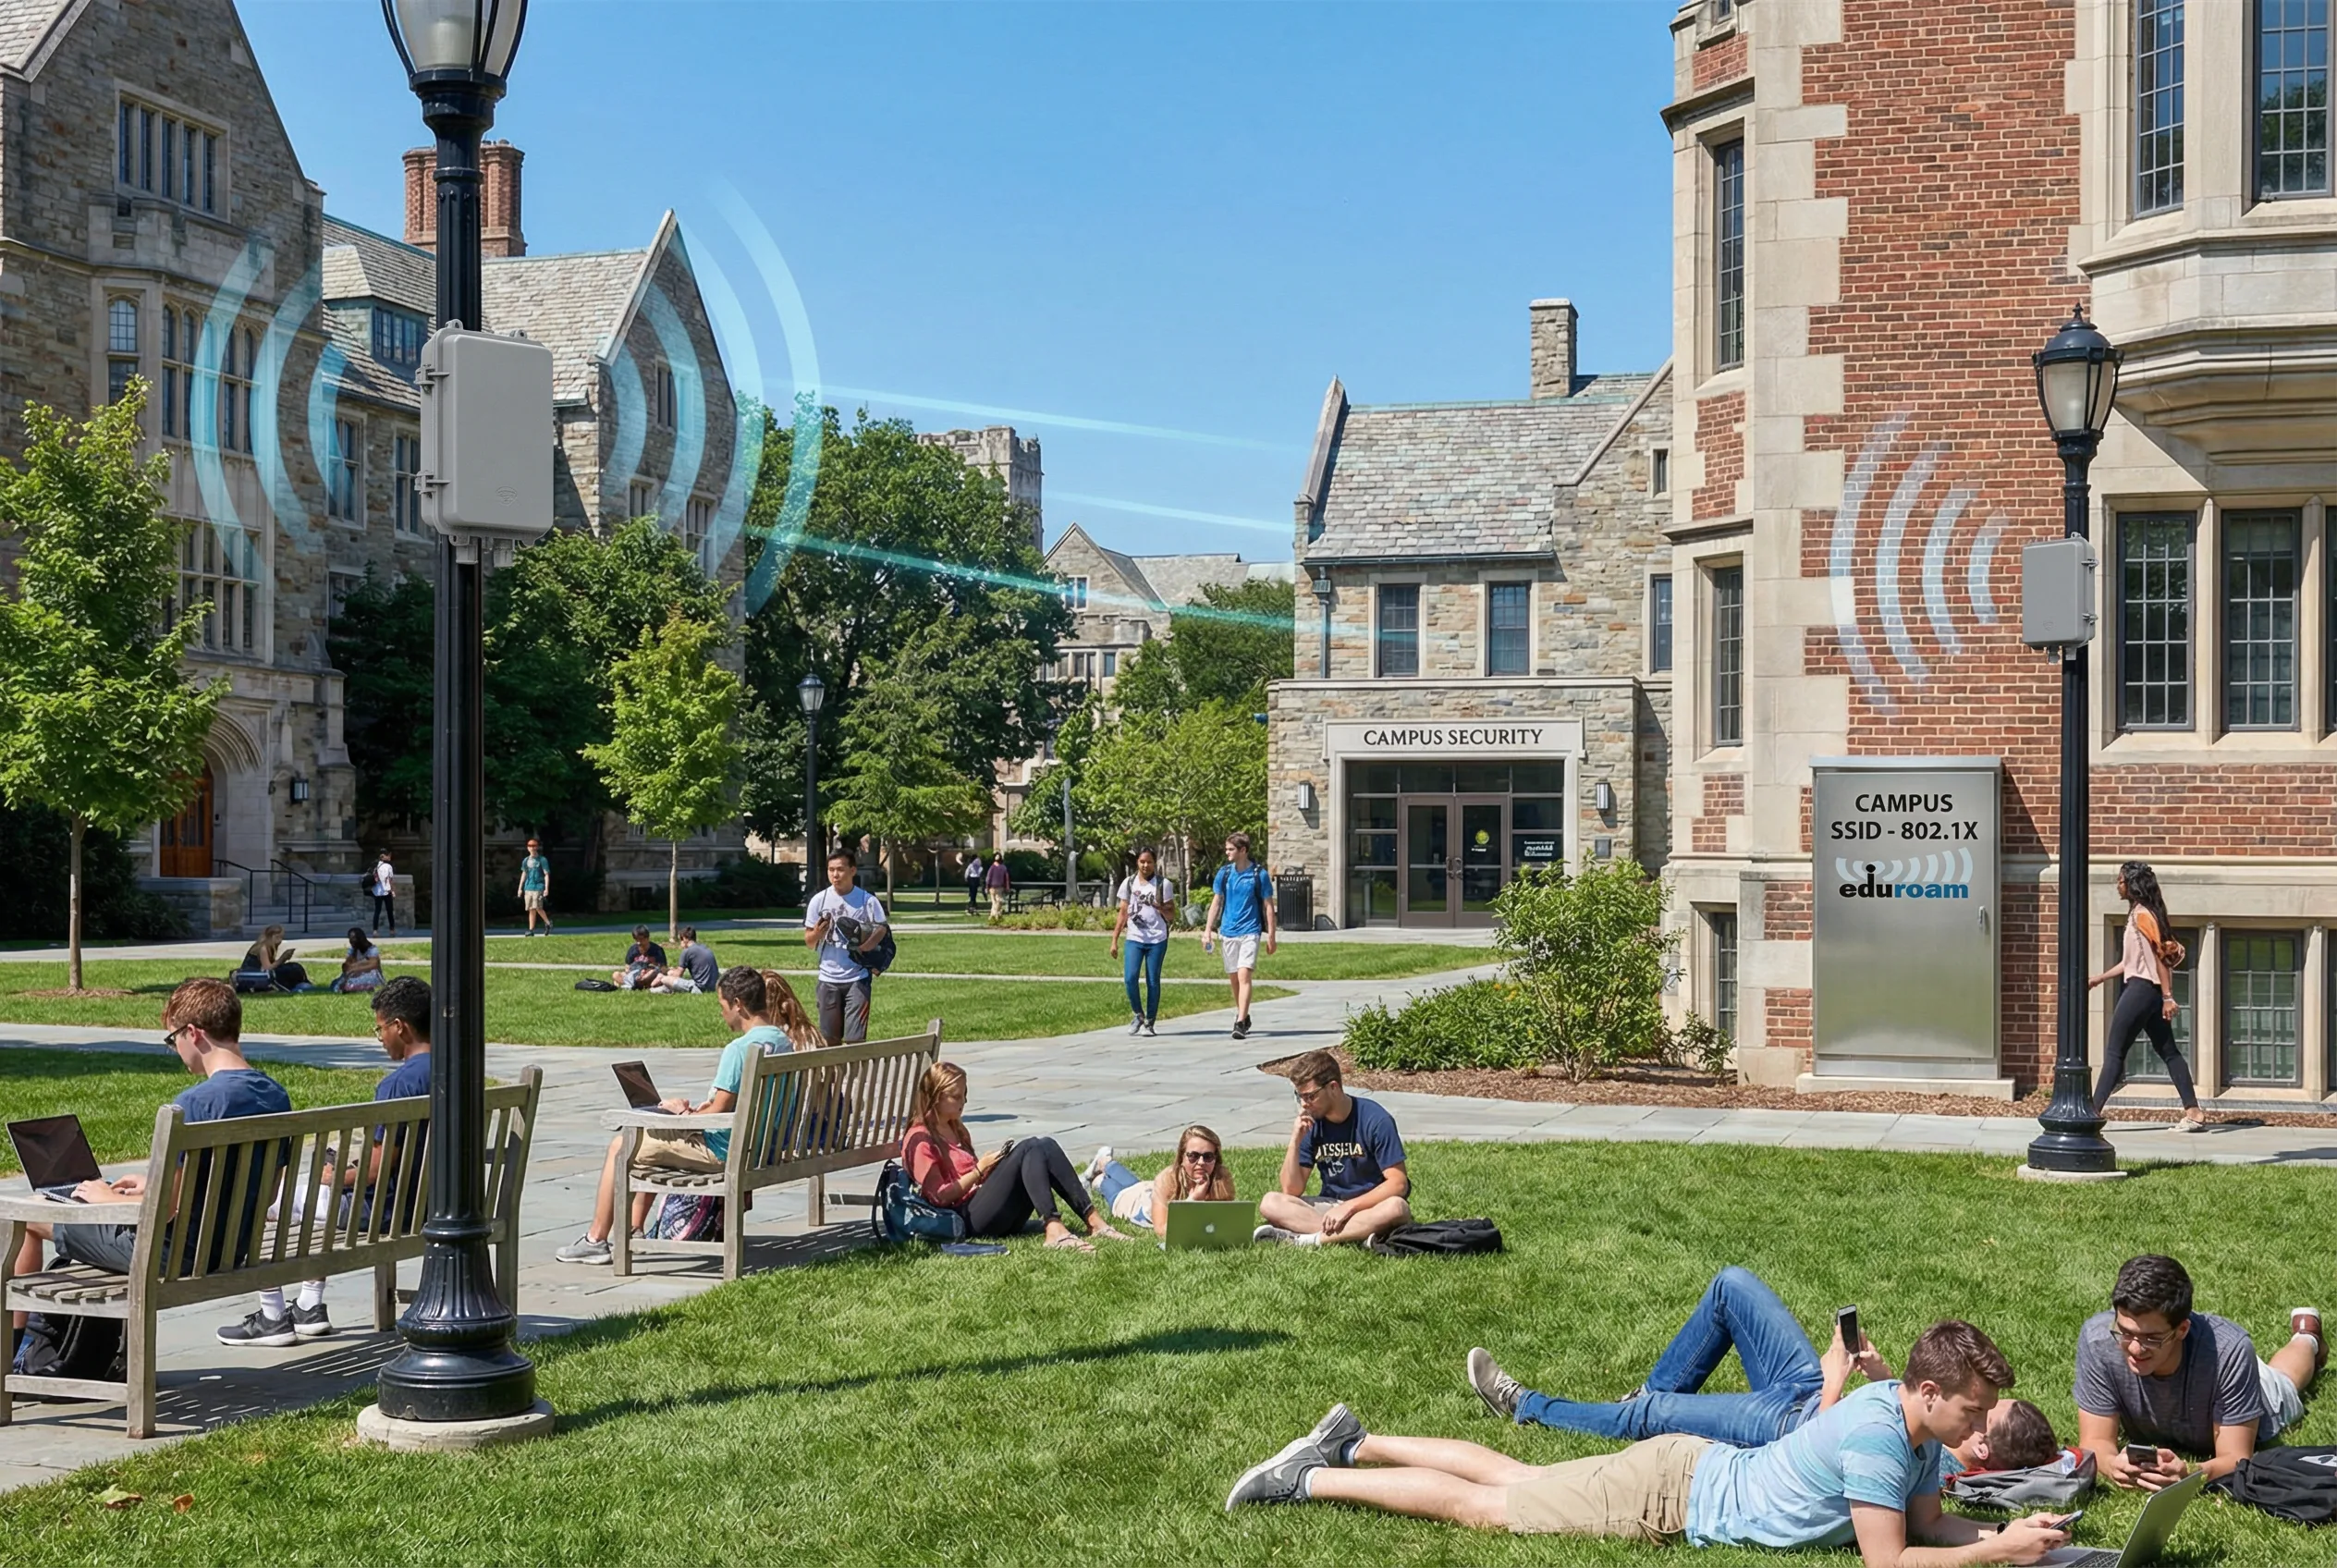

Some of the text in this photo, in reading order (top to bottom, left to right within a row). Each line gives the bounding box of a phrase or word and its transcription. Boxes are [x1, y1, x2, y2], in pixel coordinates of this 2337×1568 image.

[1364, 729, 1543, 746] CAMPUS SECURITY
[1854, 793, 1953, 813] CAMPUS
[1830, 820, 1882, 840] SSID
[1901, 820, 1978, 840] 802.1X
[1839, 864, 1969, 899] eduroam
